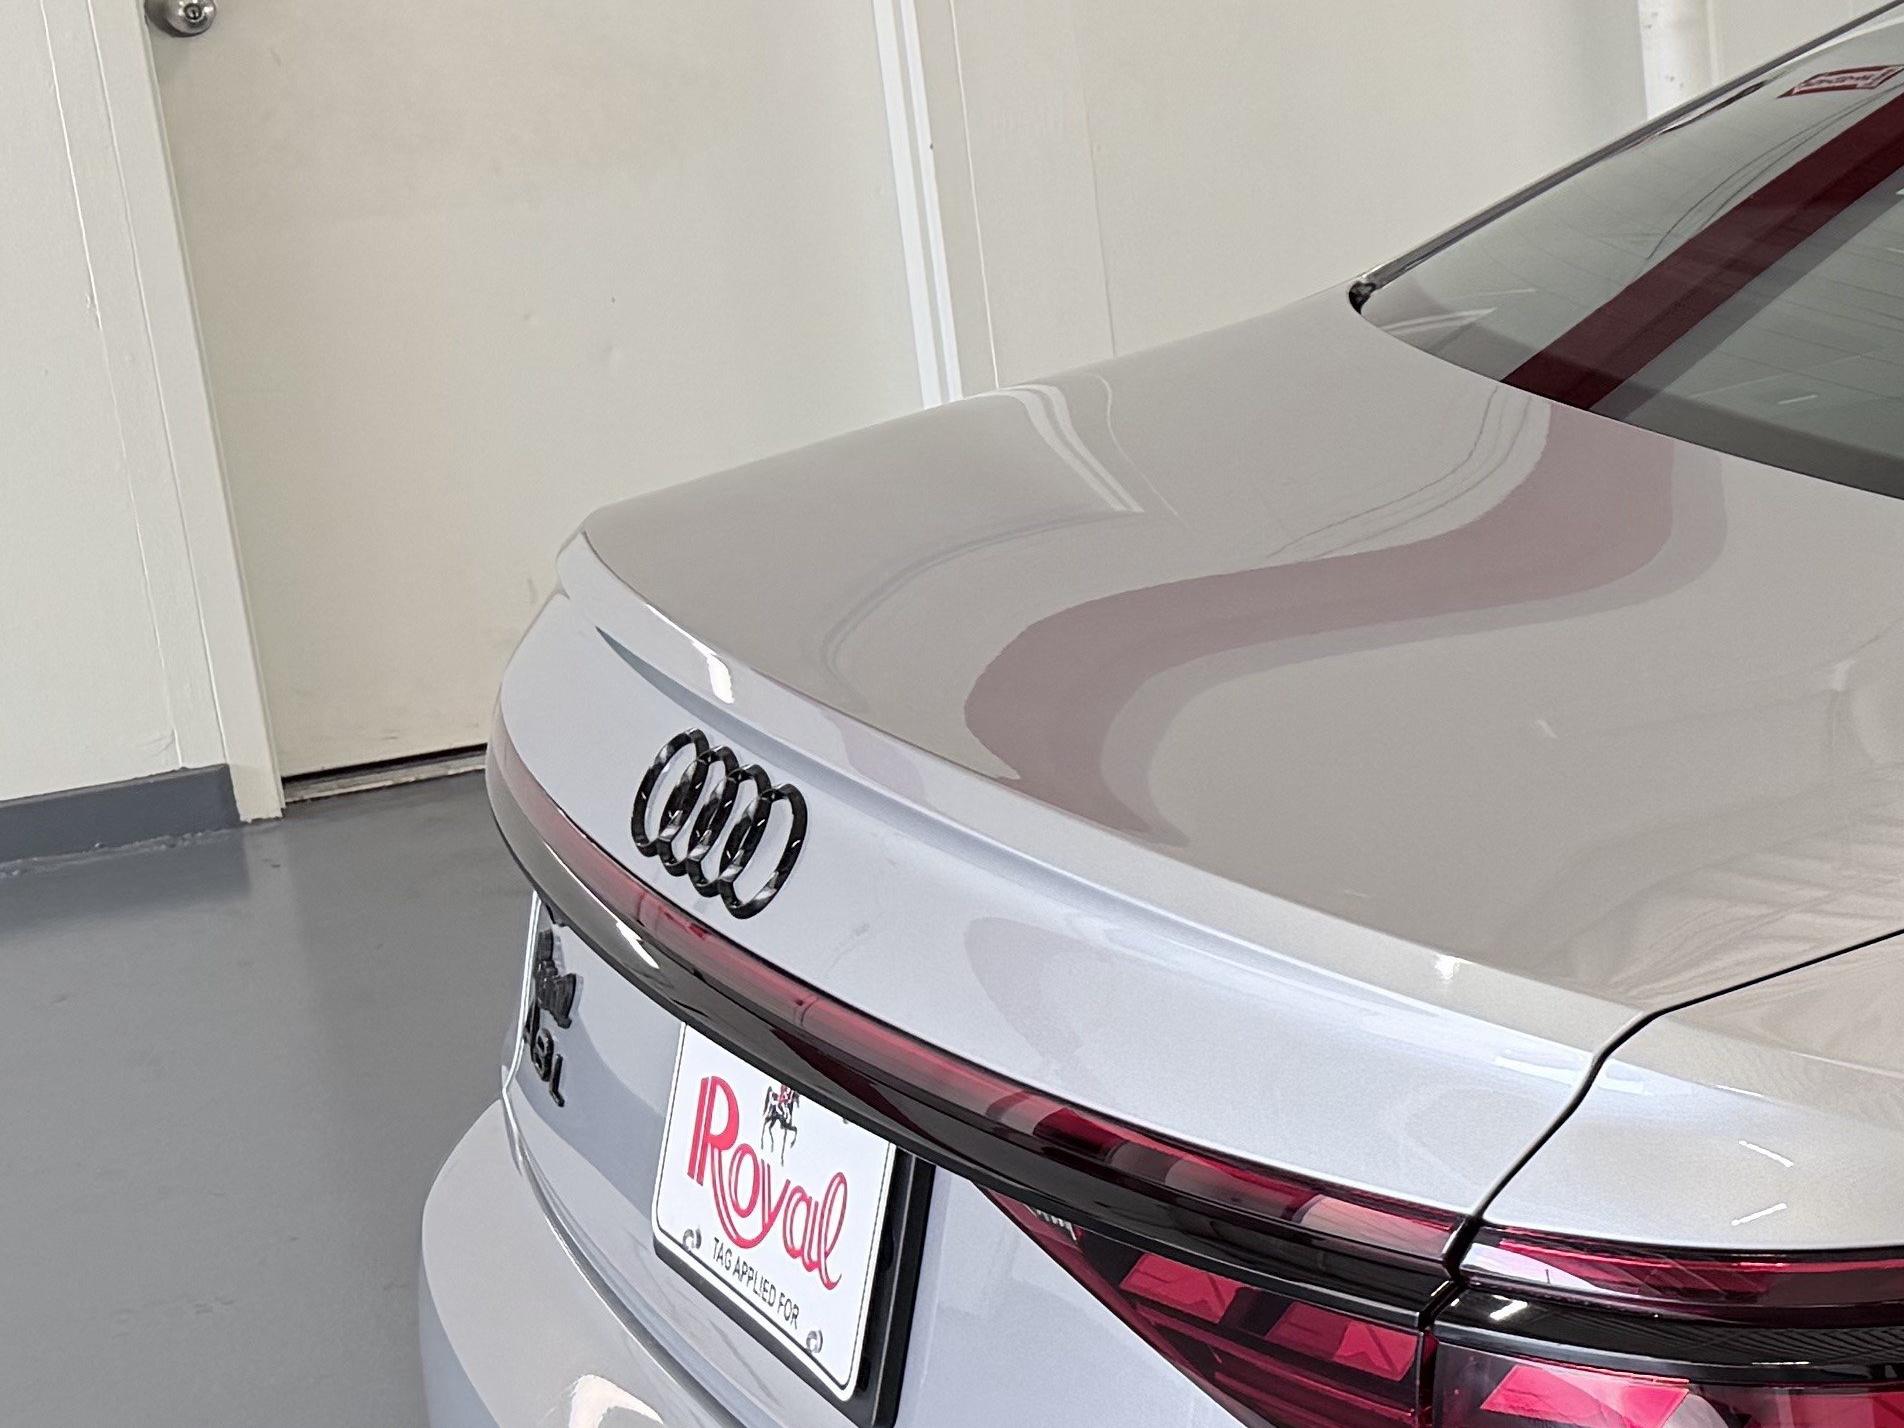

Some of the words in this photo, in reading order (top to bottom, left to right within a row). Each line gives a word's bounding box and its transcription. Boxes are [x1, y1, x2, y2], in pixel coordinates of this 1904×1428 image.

[687, 1075, 848, 1291] Royal
[712, 1236, 733, 1272] TAG
[732, 1256, 777, 1308] APPLIED
[777, 1292, 800, 1330] FOR
